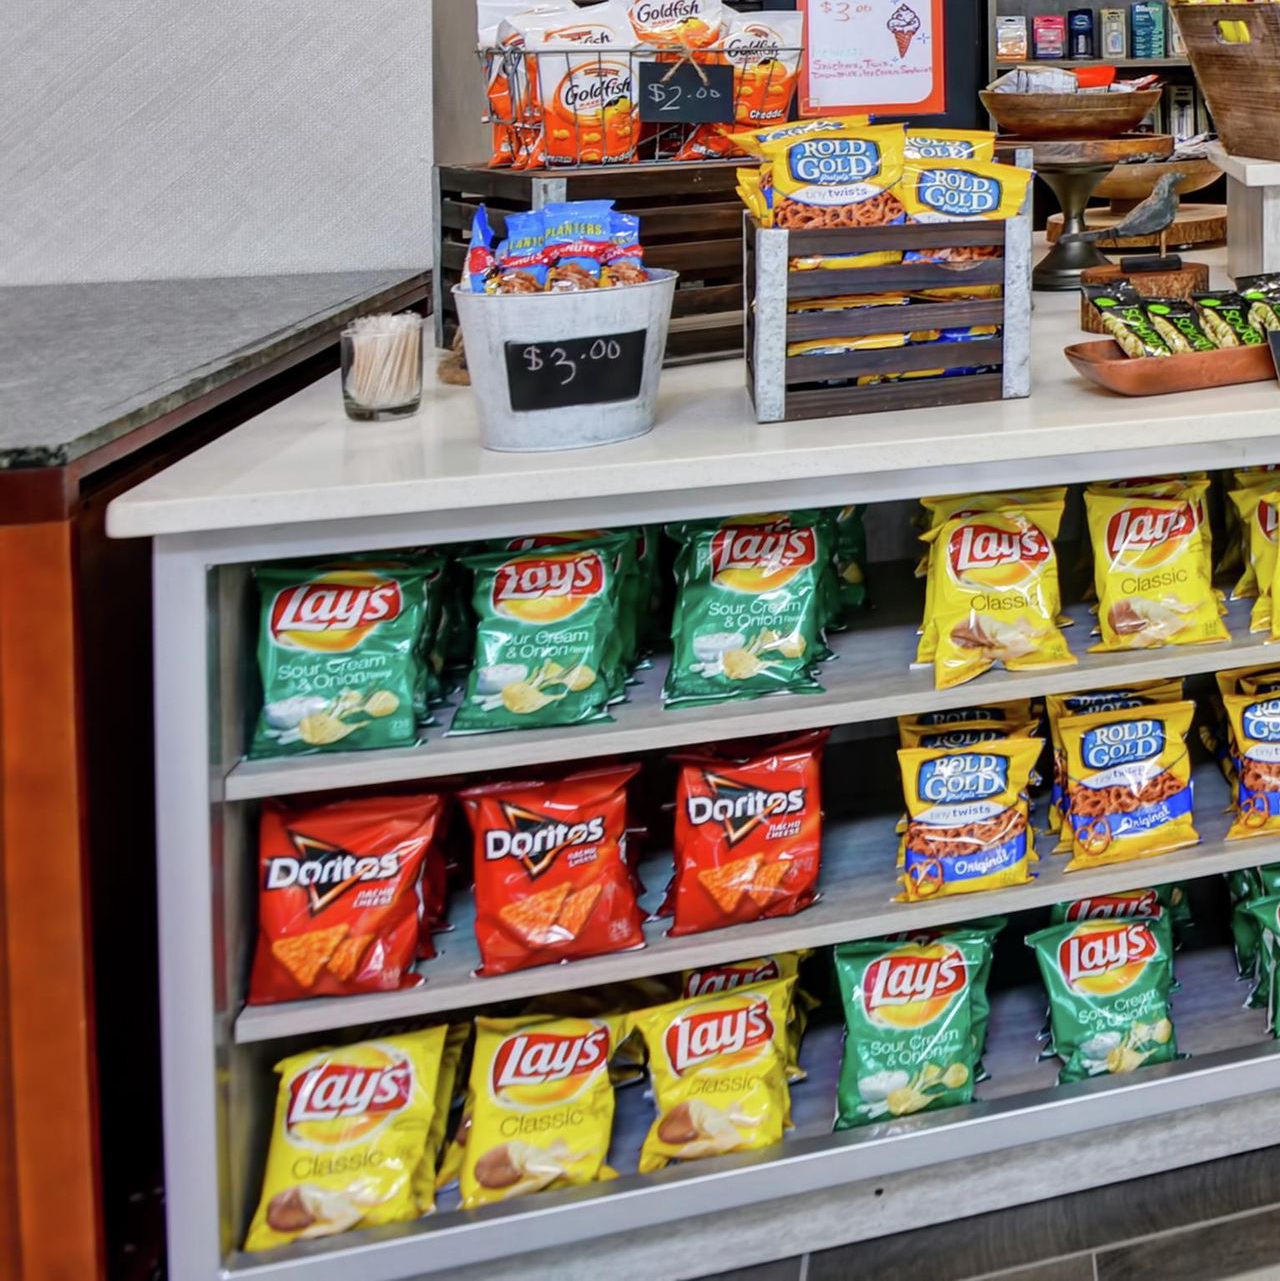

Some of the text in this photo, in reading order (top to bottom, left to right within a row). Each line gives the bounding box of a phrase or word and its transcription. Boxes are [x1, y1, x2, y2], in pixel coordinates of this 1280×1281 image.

[563, 75, 632, 107] Goldfish
[647, 83, 721, 112] $2.00
[801, 138, 870, 158] ROLD
[796, 155, 872, 181] GOLD
[827, 186, 868, 197] twists
[933, 170, 992, 193] ROLD
[924, 186, 993, 210] GOLD
[522, 339, 621, 385] $3.00
[1121, 567, 1188, 595] Classic
[708, 601, 746, 617] Sour
[724, 613, 783, 628] & Onion
[535, 630, 589, 645] Cream
[506, 643, 569, 659] & Onion
[277, 663, 321, 681] Sour
[297, 669, 367, 695] & Onion
[1095, 720, 1154, 746] ROLD
[934, 754, 999, 775] ROLD
[1088, 737, 1158, 767] GOLD
[924, 771, 999, 800] GOLD
[688, 788, 805, 825] Doritos
[952, 805, 991, 817] twists
[485, 816, 604, 860] Doritos
[765, 827, 801, 840] CHEESE
[266, 853, 401, 890] Doritos
[954, 846, 1014, 875] Original
[1114, 989, 1159, 1011] Cream
[870, 1039, 905, 1057] Sour
[500, 1108, 584, 1137] Classic
[291, 1149, 385, 1180] Classic
